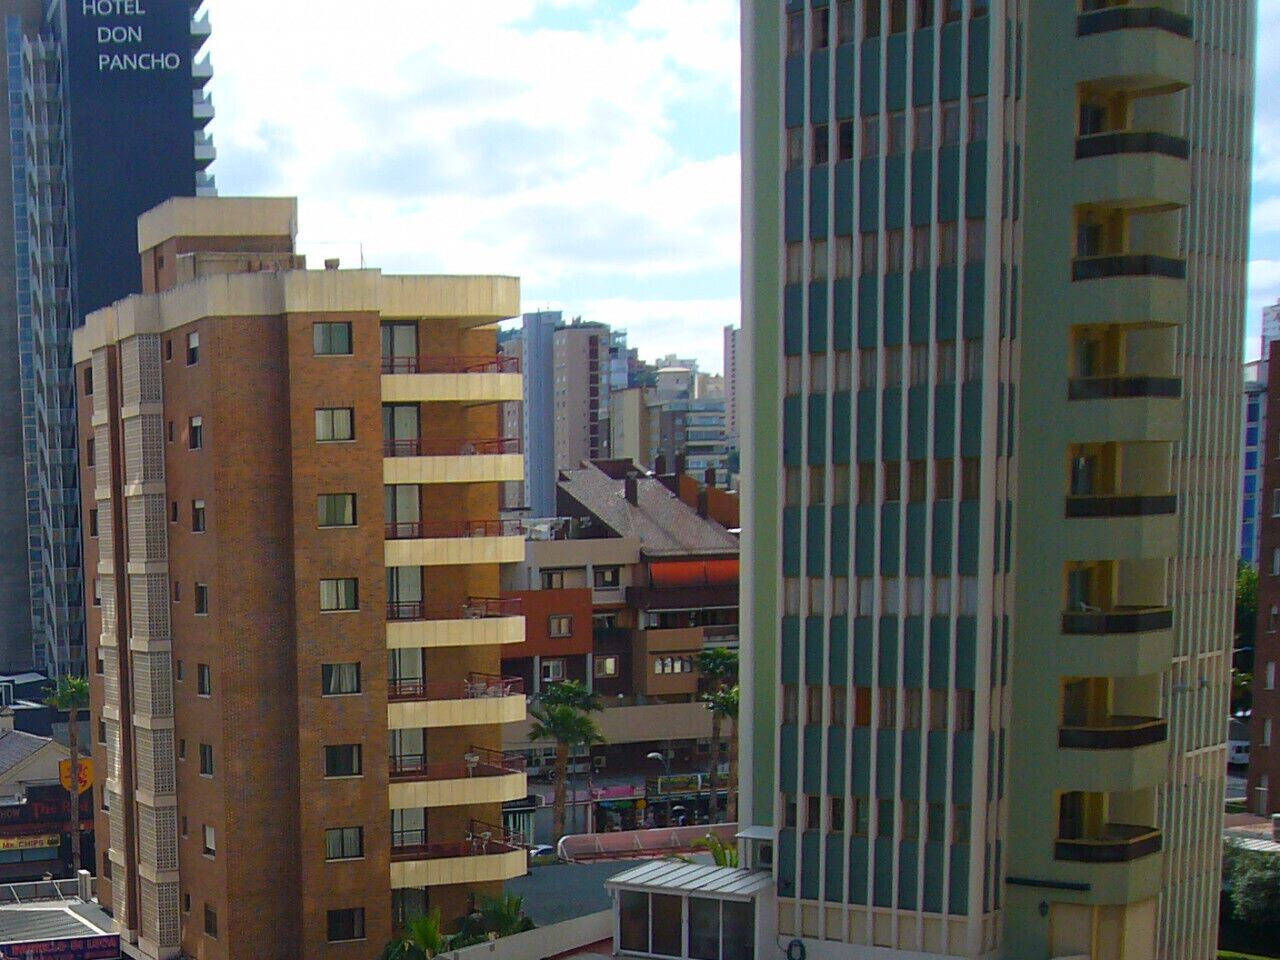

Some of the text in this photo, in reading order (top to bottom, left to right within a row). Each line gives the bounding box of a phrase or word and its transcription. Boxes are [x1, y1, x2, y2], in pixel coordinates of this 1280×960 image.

[82, 0, 146, 15] HOTEL
[97, 26, 143, 43] DON
[98, 53, 180, 71] PANCHO
